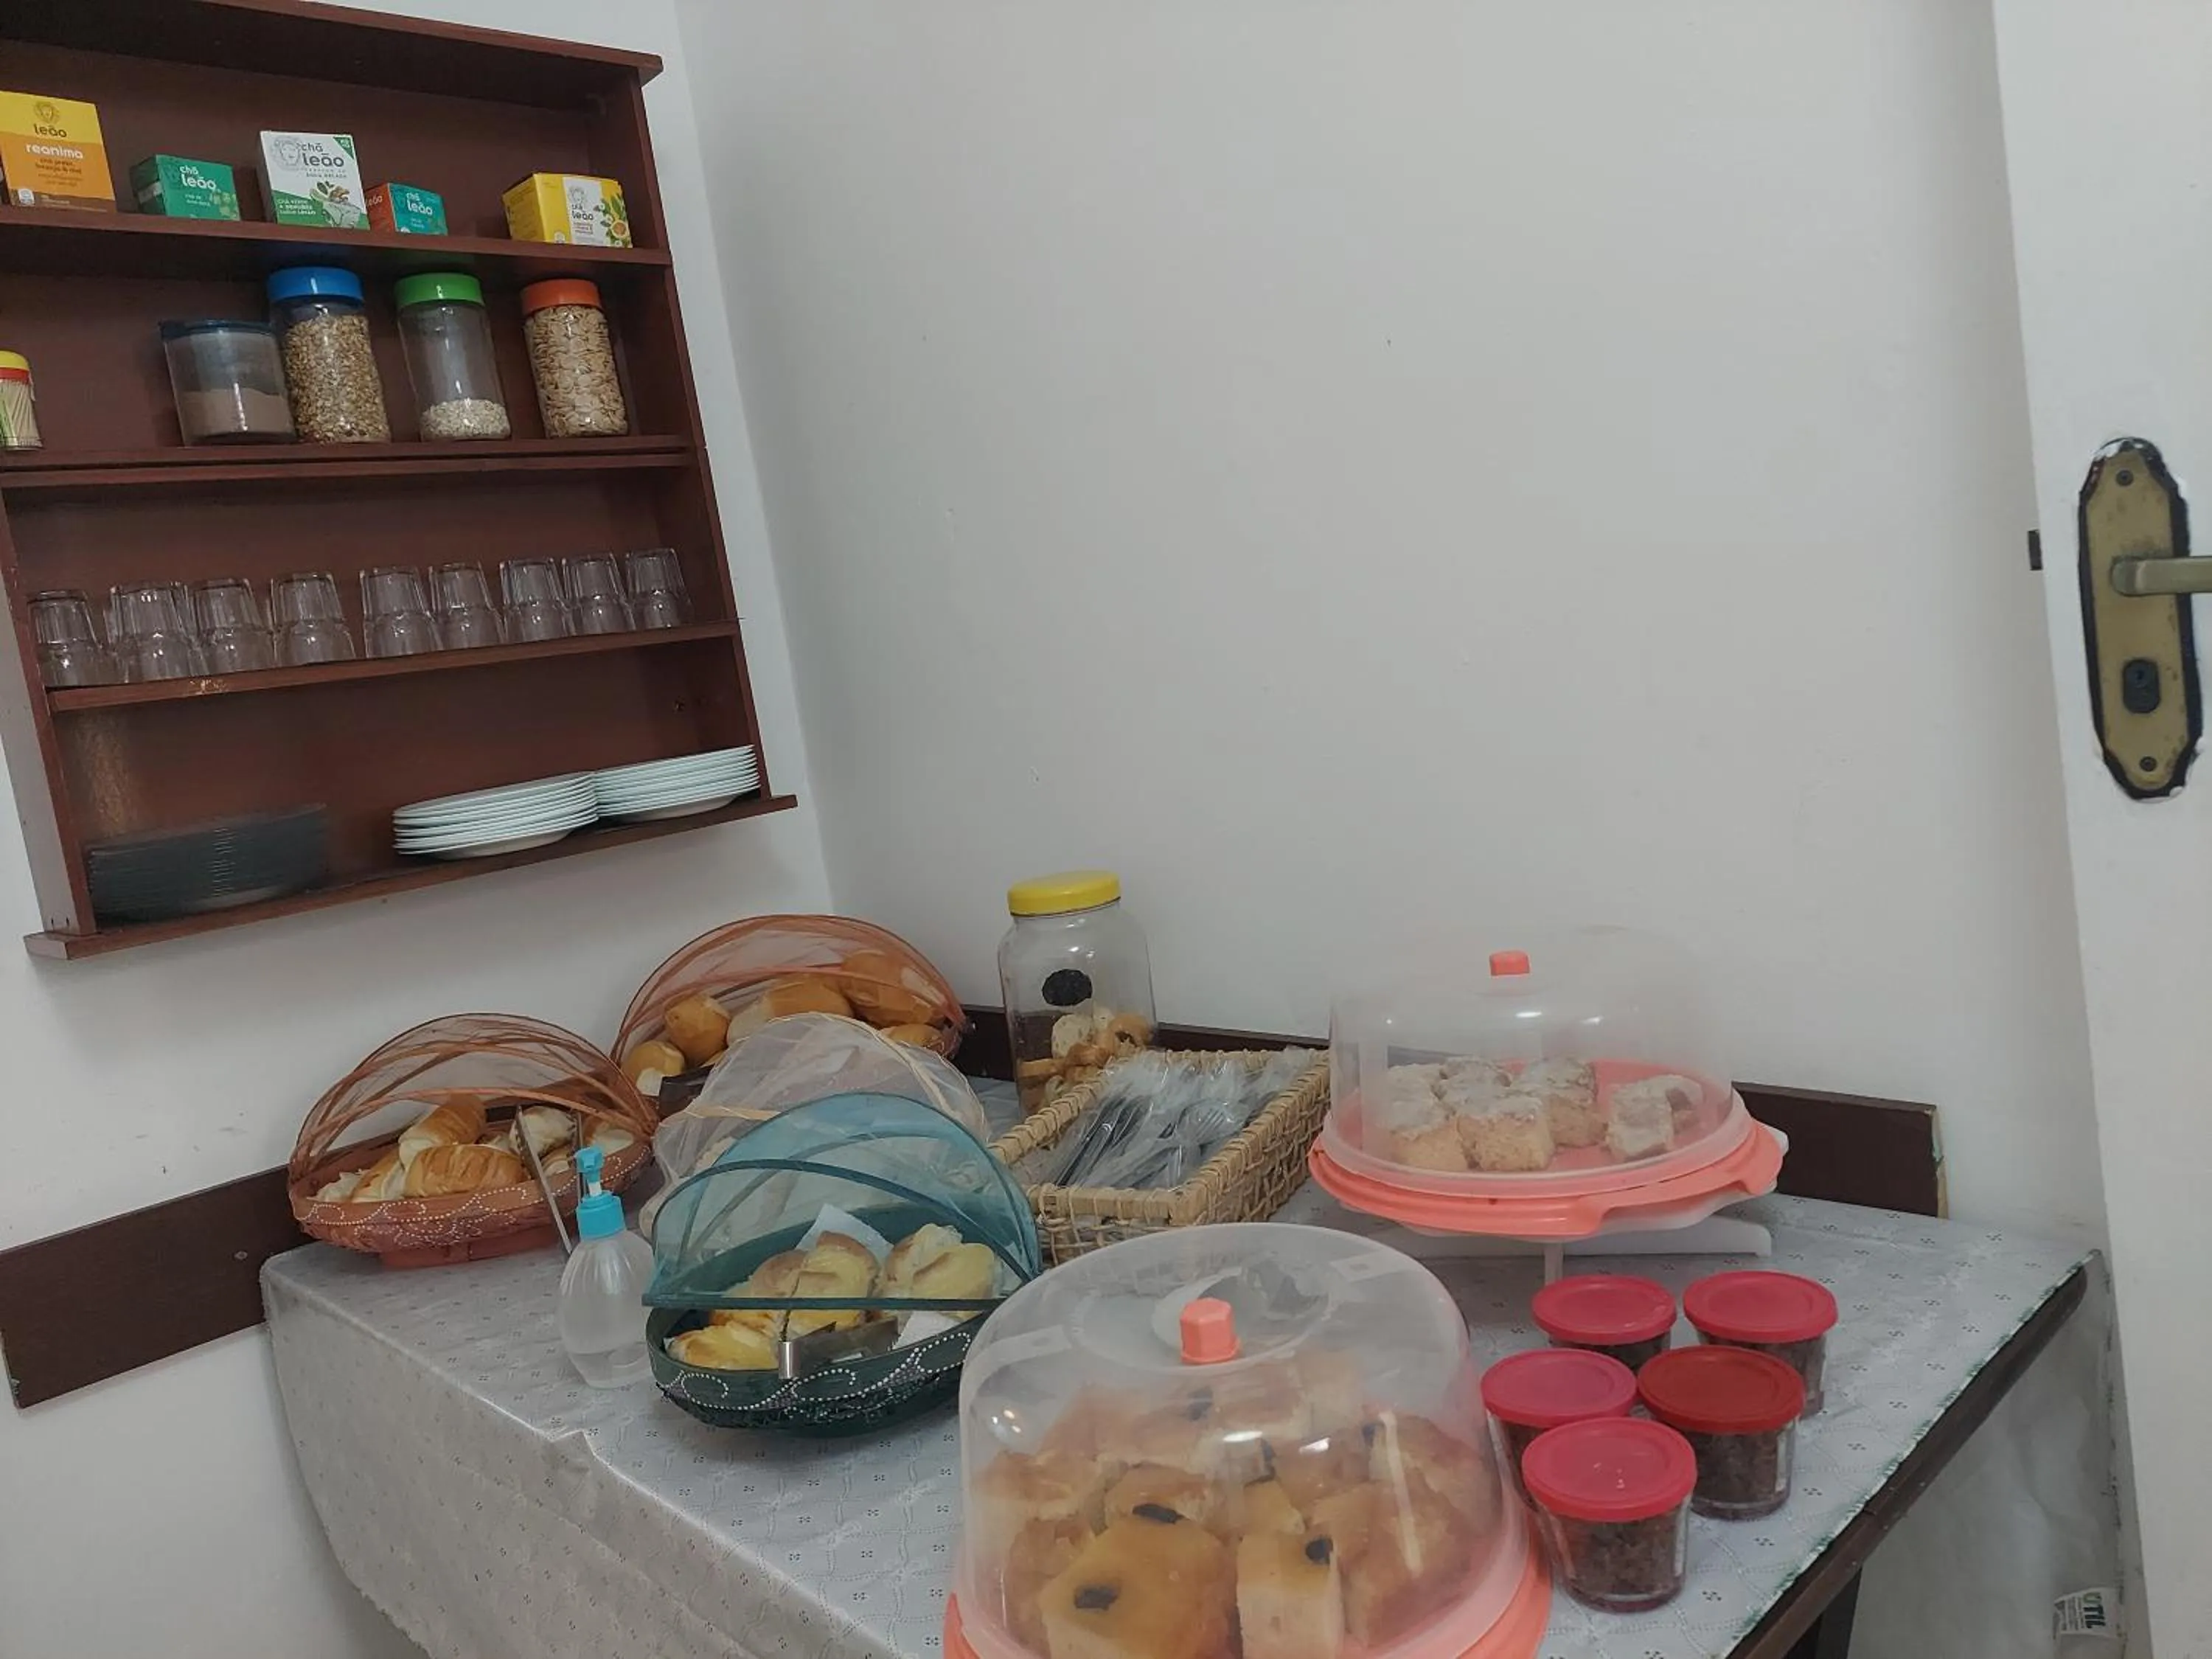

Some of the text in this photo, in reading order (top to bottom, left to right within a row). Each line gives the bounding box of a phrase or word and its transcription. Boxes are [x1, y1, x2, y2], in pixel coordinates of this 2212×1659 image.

[34, 124, 67, 137] leão
[26, 144, 83, 159] reanima
[301, 142, 324, 153] chá
[302, 153, 345, 167] leão
[179, 165, 200, 175] chá
[181, 173, 217, 190] leão
[407, 200, 434, 217] leão
